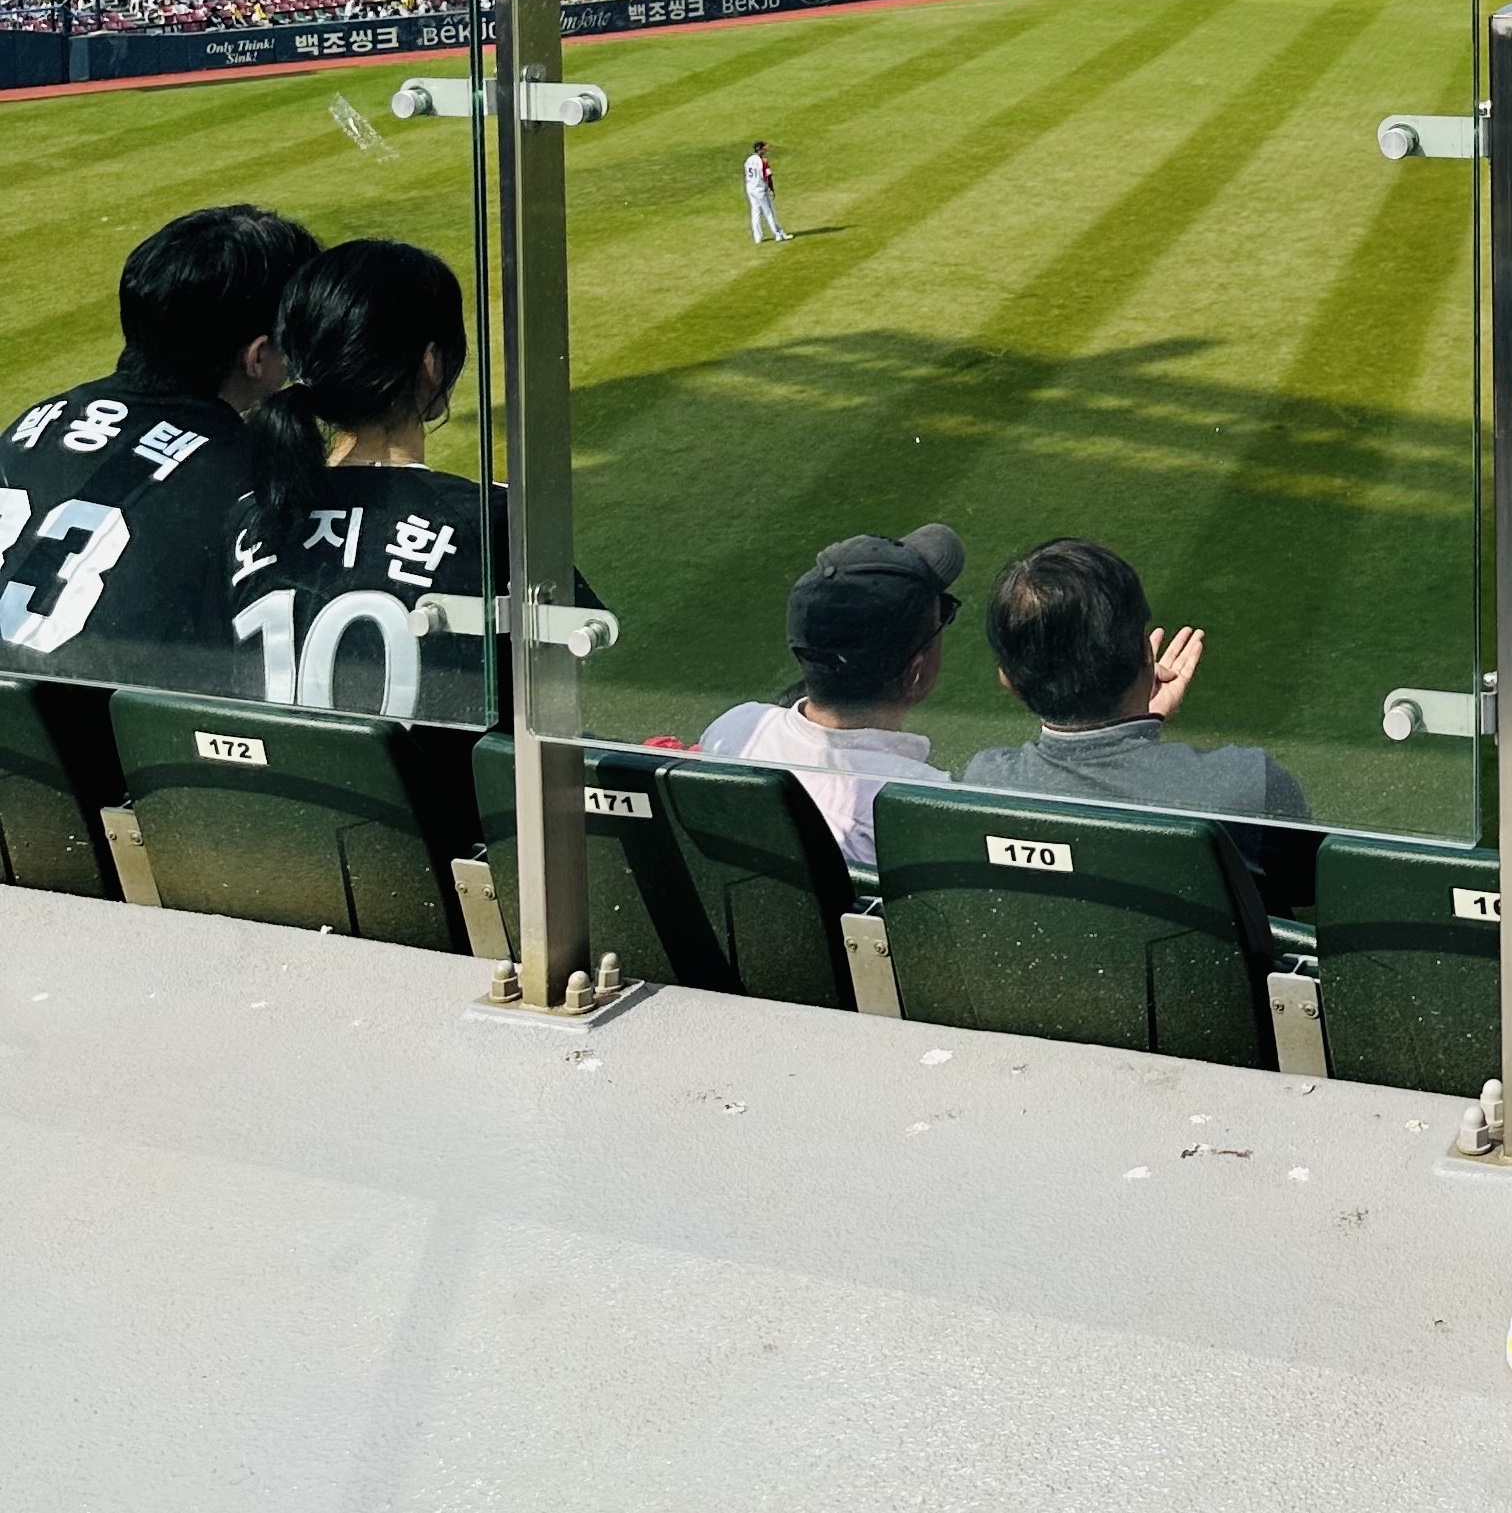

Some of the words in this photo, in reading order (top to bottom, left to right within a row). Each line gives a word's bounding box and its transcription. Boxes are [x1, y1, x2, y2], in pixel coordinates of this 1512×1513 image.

[206, 42, 234, 55] Only
[237, 37, 275, 52] Think!
[295, 26, 399, 56] 백조씽크
[8, 399, 208, 482] 박용택
[231, 588, 421, 732] 10
[208, 738, 252, 759] 172
[588, 792, 634, 813] 171
[1004, 843, 1056, 867] 170
